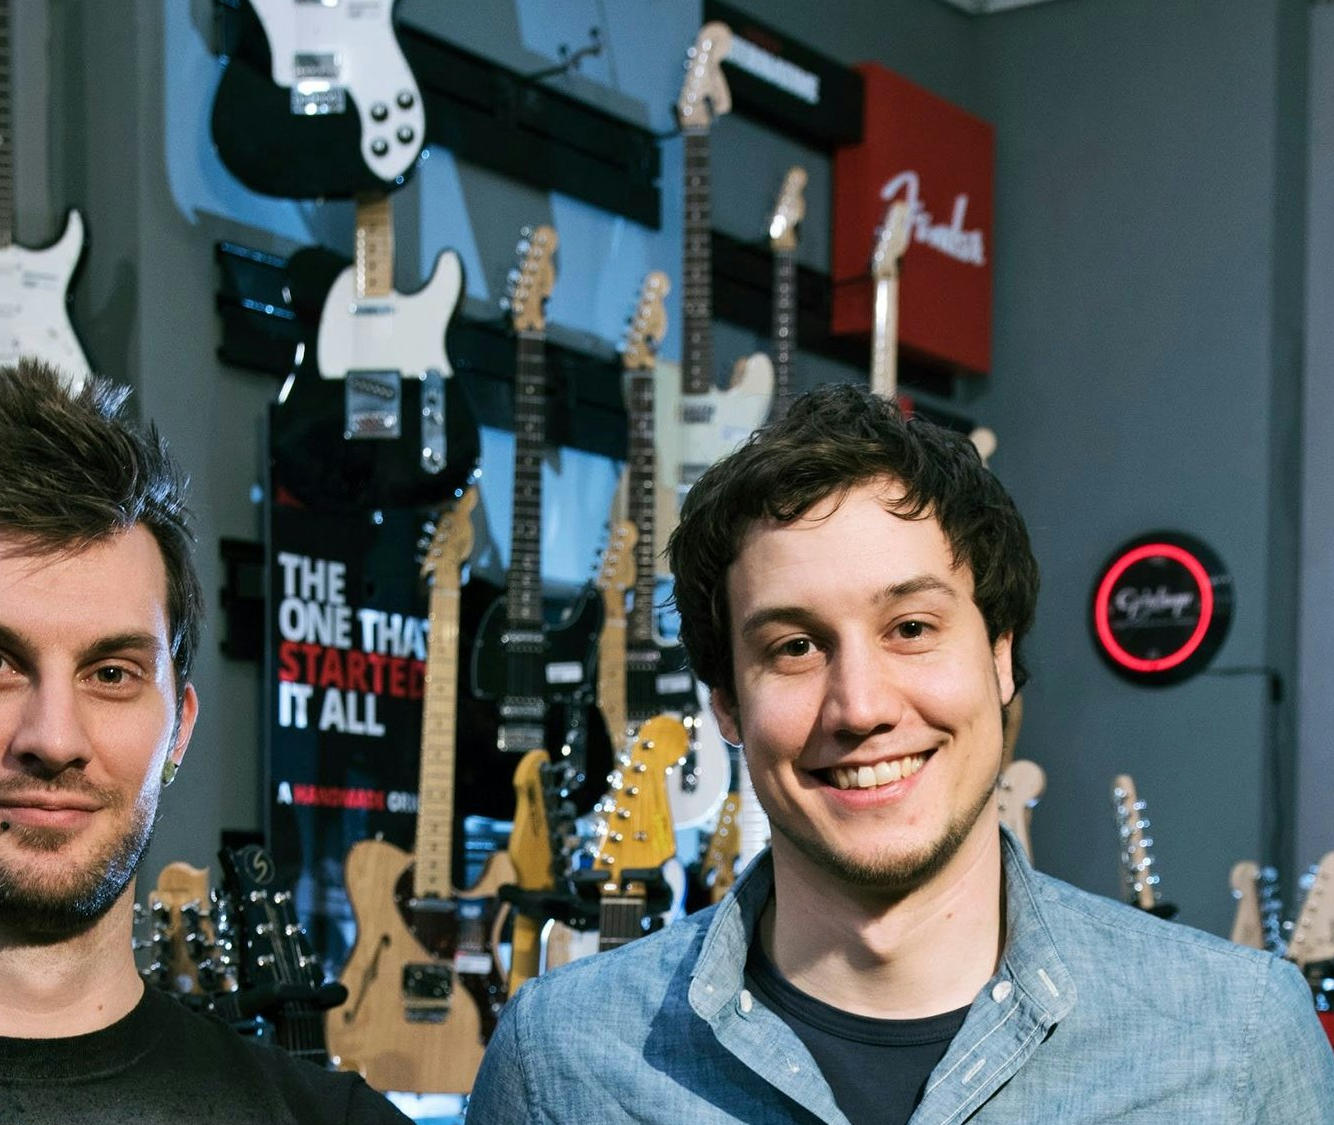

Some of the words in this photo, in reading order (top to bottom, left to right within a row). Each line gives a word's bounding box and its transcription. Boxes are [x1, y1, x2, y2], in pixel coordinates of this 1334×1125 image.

[278, 551, 347, 605] THE
[279, 597, 353, 649] ONE
[278, 640, 427, 698] STARTED
[279, 681, 313, 729] IT
[319, 687, 386, 737] ALL
[277, 781, 293, 805] A
